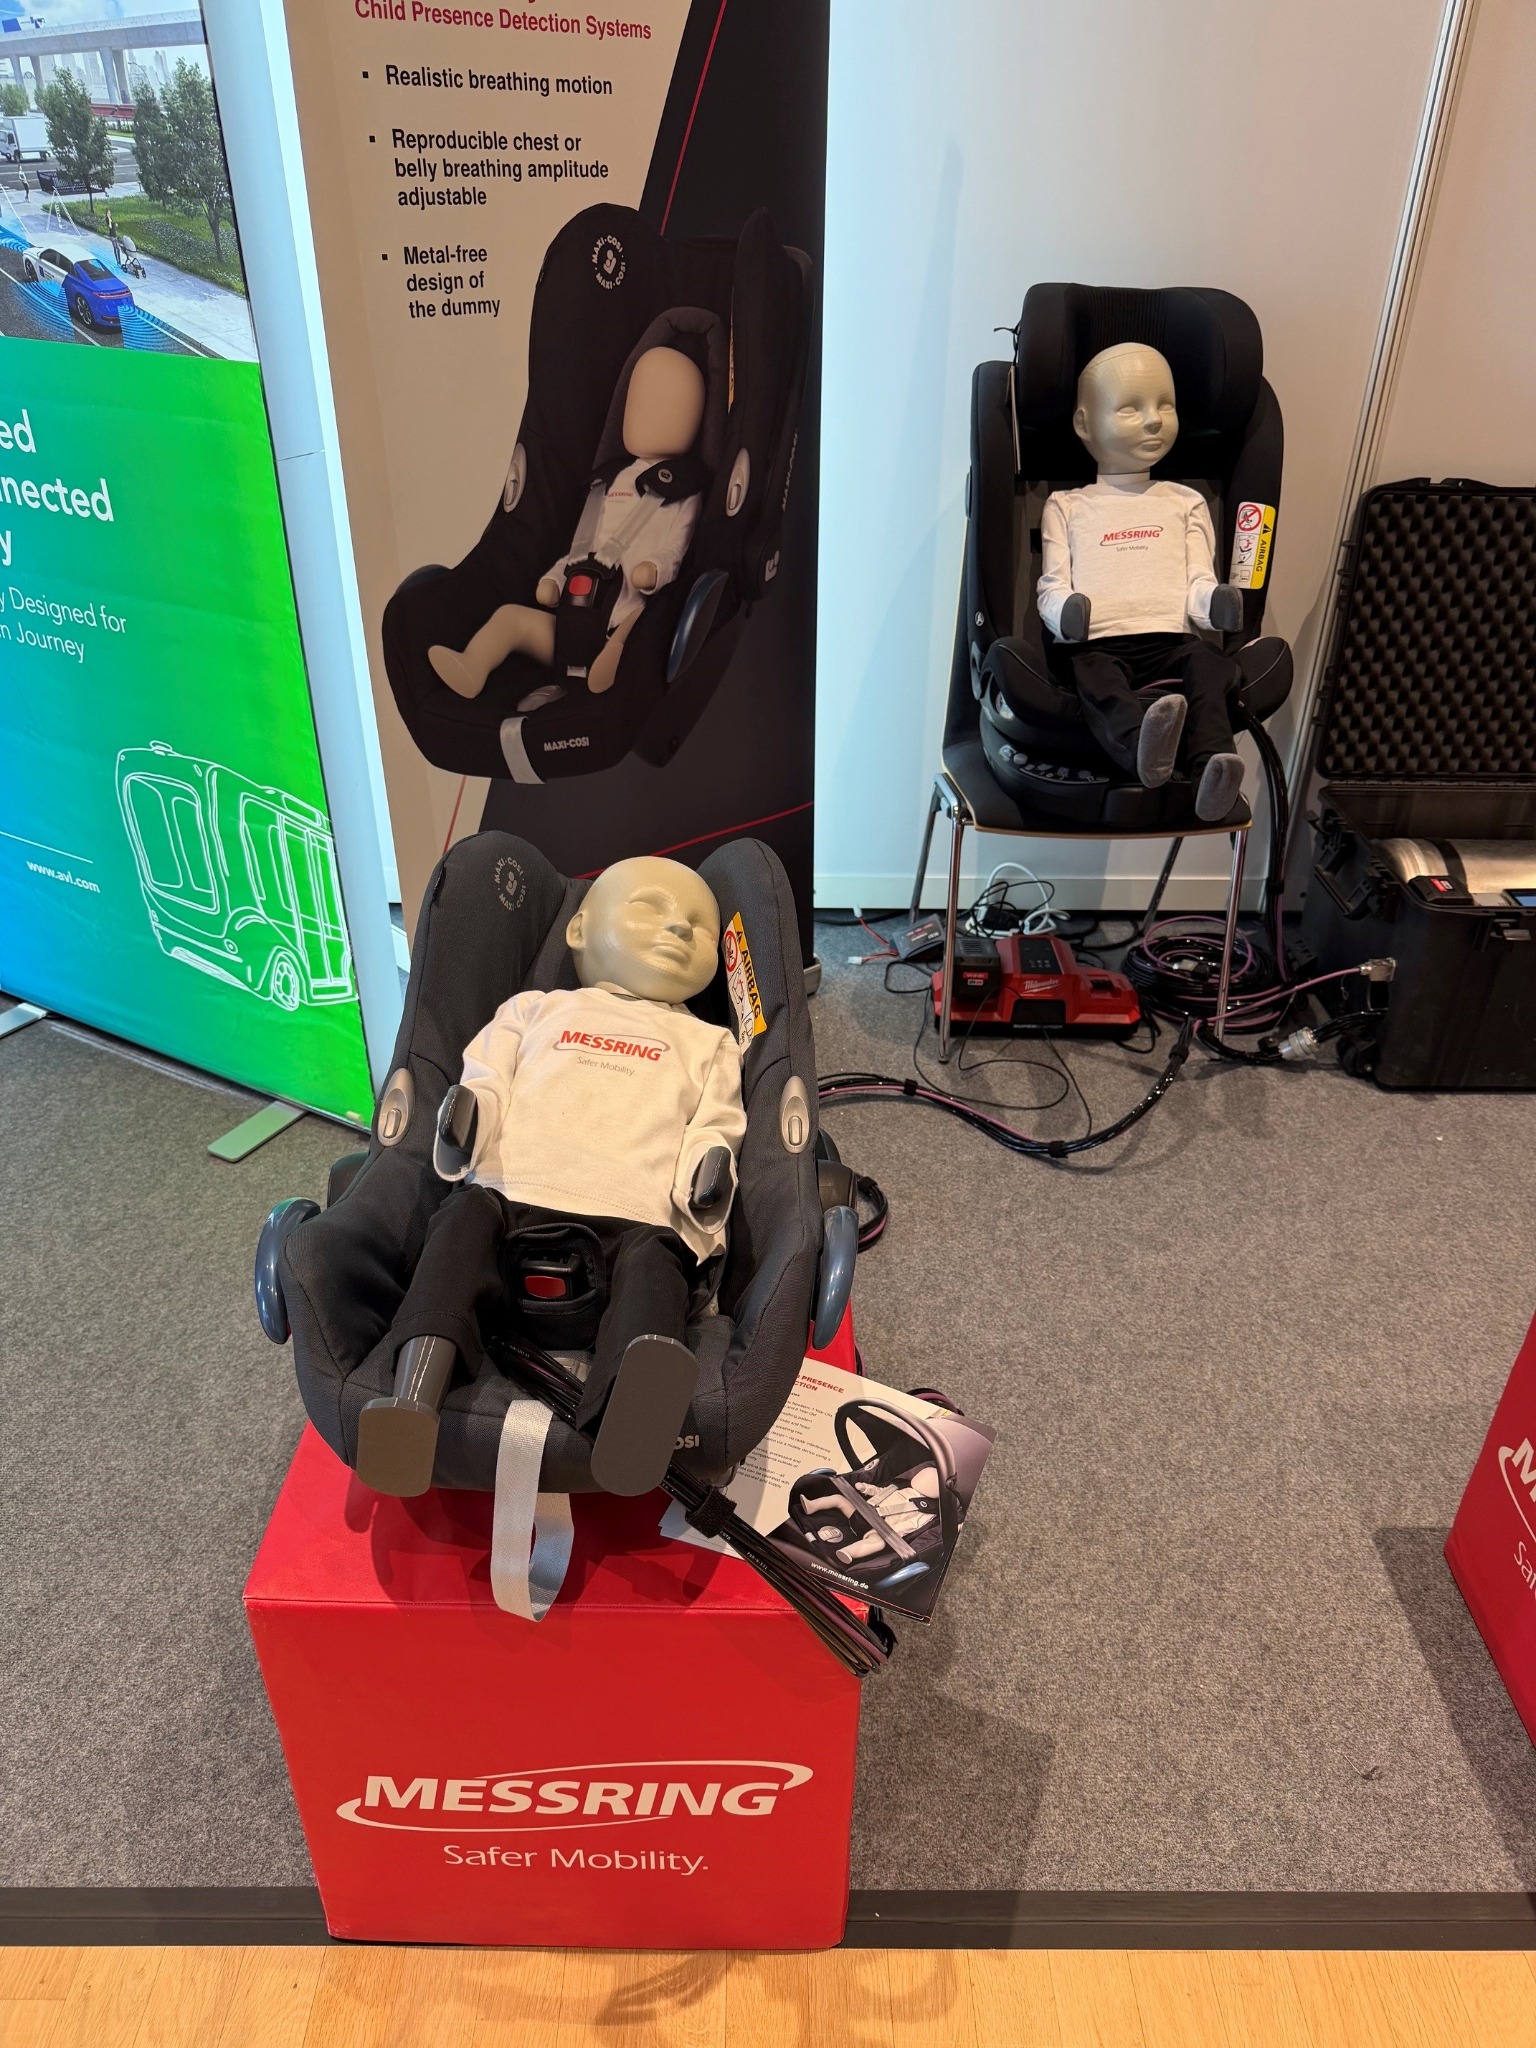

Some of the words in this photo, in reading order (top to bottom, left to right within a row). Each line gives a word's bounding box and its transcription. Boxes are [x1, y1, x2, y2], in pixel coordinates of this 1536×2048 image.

[355, 0, 406, 21] Child
[412, 1, 494, 28] Presence
[499, 9, 581, 33] Detection
[586, 15, 652, 40] Systems
[386, 65, 463, 88] Realistic
[469, 69, 550, 97] breathing
[556, 76, 613, 94] motion
[392, 128, 508, 153] Reproducible
[513, 132, 559, 151] chest
[565, 137, 582, 151] or
[395, 158, 437, 182] belly
[443, 158, 522, 182] breathing
[528, 159, 609, 182] amplitude
[398, 187, 488, 210] adjustable
[403, 245, 488, 265] Metal-free
[406, 273, 464, 294] design
[469, 270, 485, 288] of
[409, 300, 436, 318] the
[442, 299, 500, 318] dummy
[0, 477, 114, 522] nected
[1103, 530, 1160, 542] MESSRING
[1256, 539, 1267, 573] AIRBAG
[8, 586, 98, 628] Designed
[100, 605, 127, 633] for
[16, 622, 85, 664] Journey
[26, 861, 101, 894] www.avl.com
[741, 949, 761, 1019] AIRBAG
[560, 1030, 662, 1062] MESSRING
[576, 1056, 598, 1068] Safer
[801, 1375, 845, 1394] PRESENCE
[811, 1561, 869, 1590] www.messring.de
[364, 1775, 780, 1816] MESSRING
[442, 1844, 539, 1868] Safer
[550, 1847, 709, 1877] Mobility.
